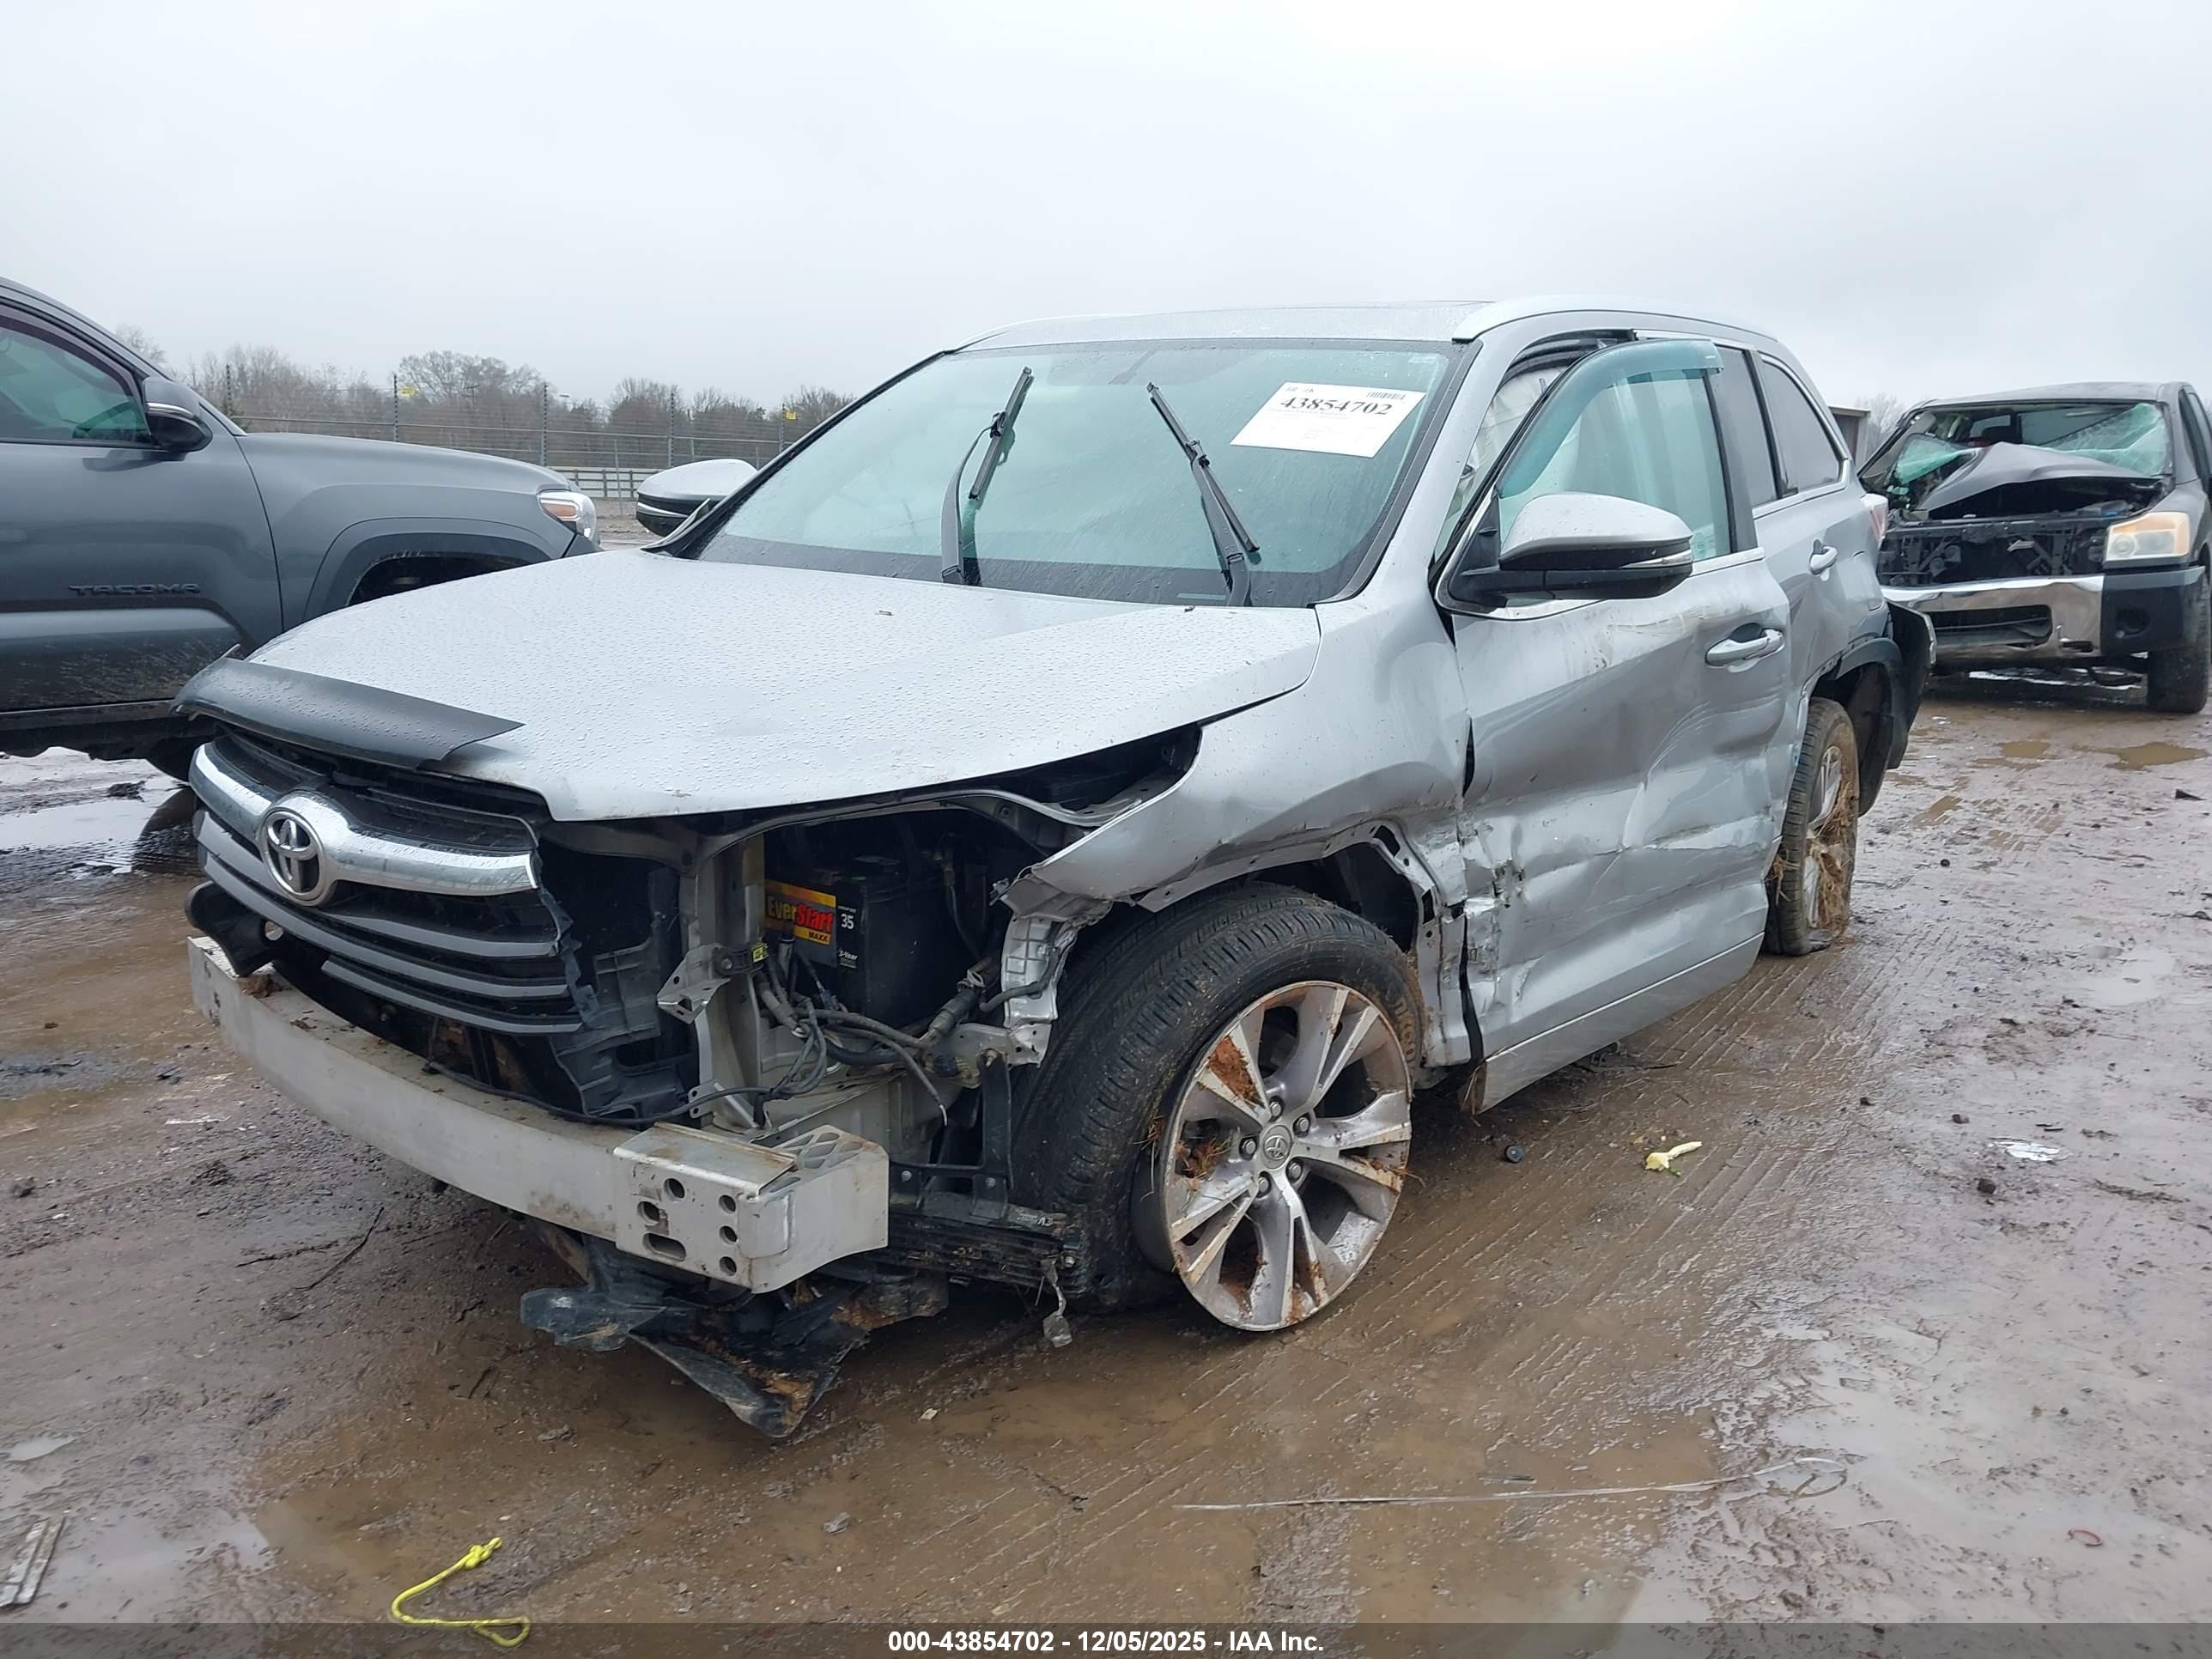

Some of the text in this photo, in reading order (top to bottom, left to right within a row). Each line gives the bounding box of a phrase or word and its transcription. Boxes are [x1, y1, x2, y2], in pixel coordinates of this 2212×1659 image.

[1280, 396, 1393, 415] 43854702
[69, 583, 201, 596] TACOMA
[841, 913, 854, 930] 35
[809, 932, 828, 942] MAXX
